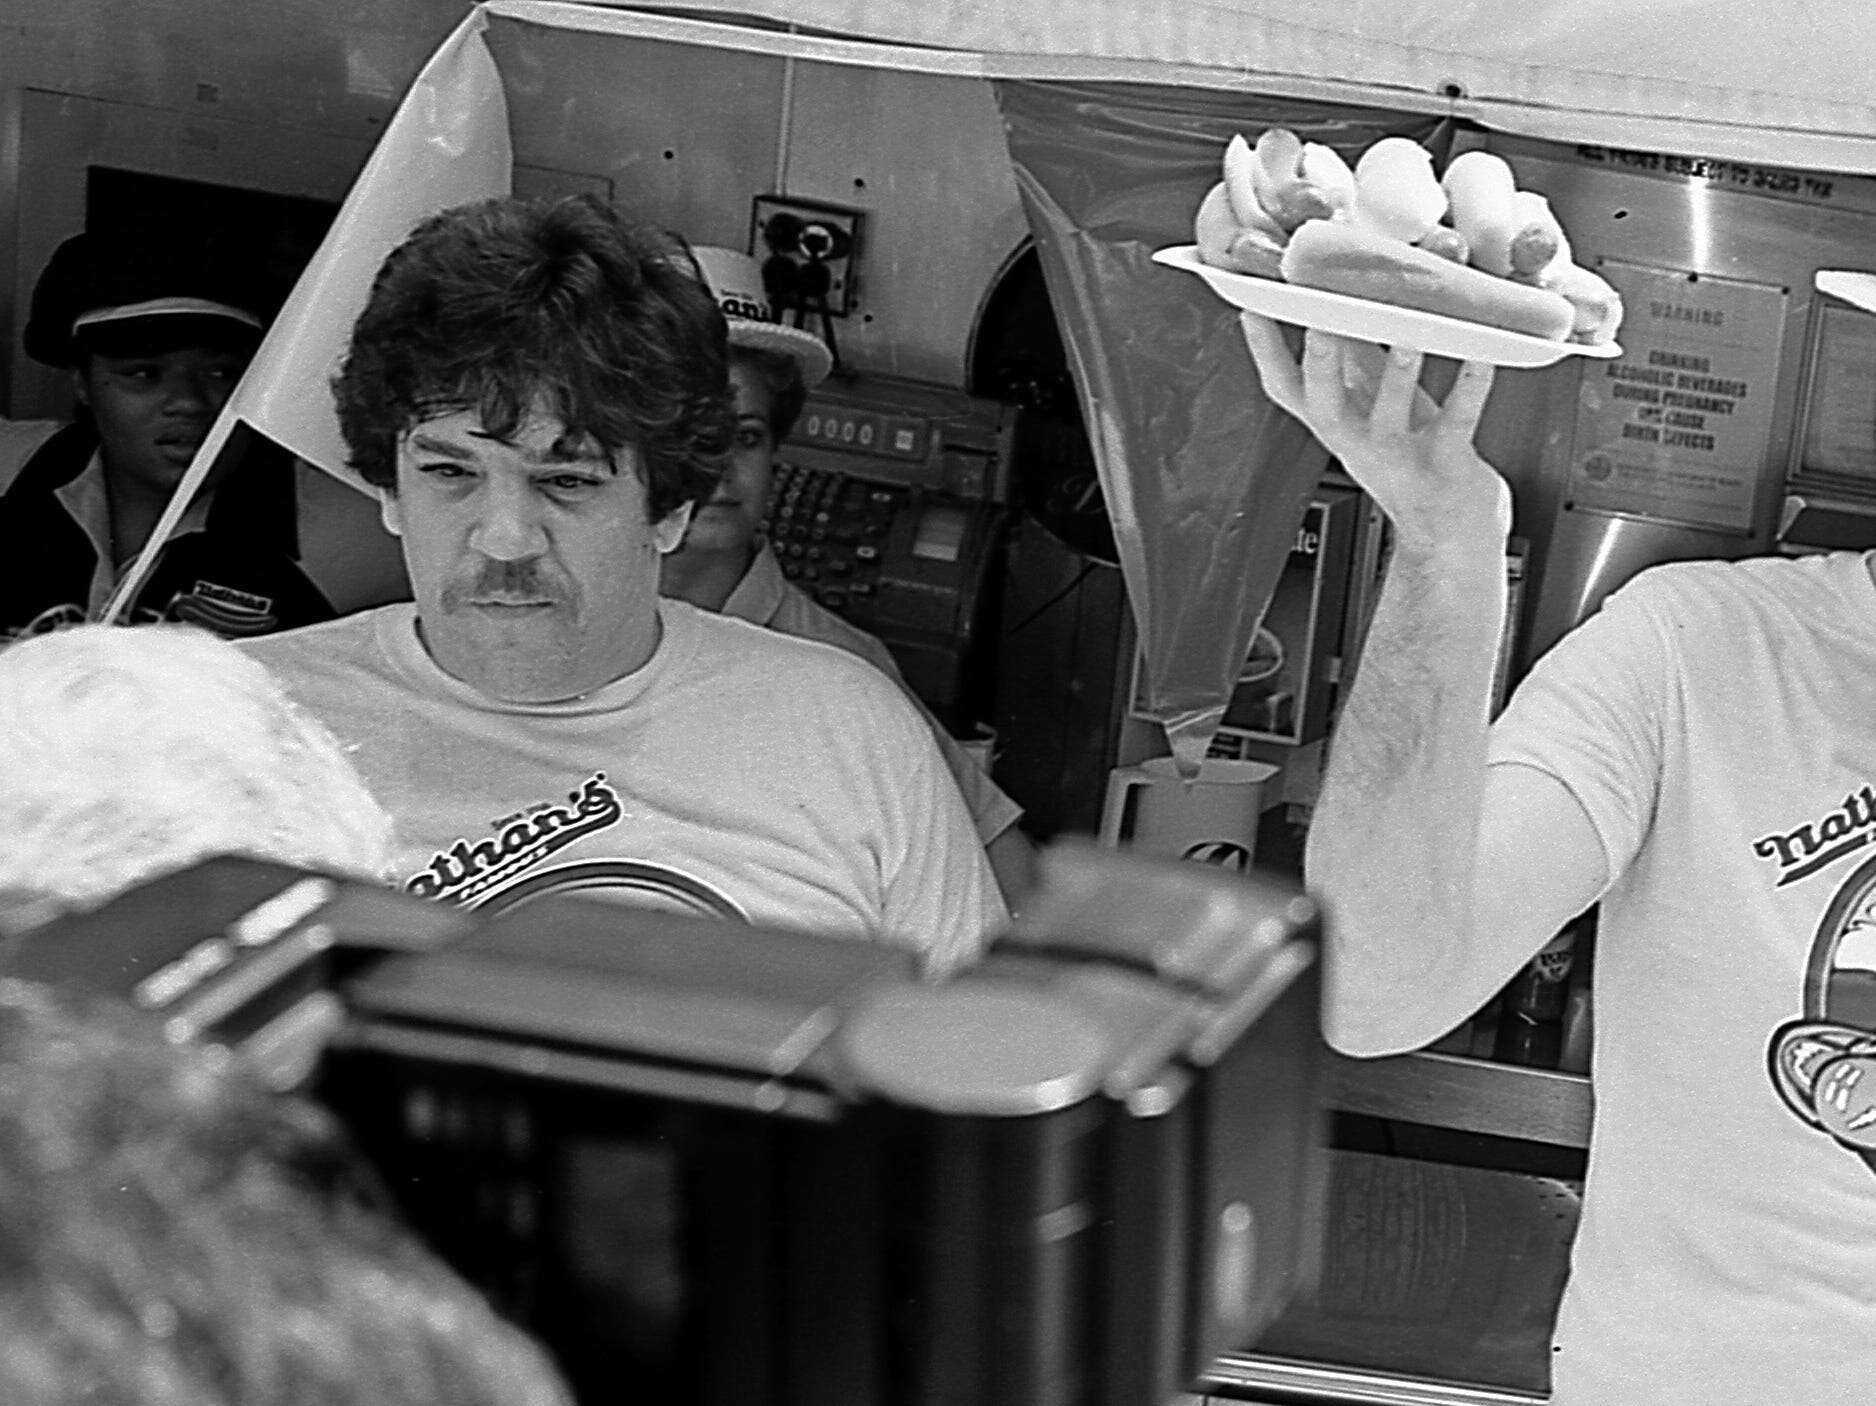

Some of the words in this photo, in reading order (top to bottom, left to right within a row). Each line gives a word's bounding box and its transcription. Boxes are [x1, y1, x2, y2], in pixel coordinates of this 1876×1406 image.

[1650, 301, 1726, 327] WARNING
[1649, 350, 1710, 373] DRINKING
[1606, 362, 1674, 387] ALCOHOLIC
[1677, 373, 1747, 399] BEVERAGES
[1613, 383, 1660, 403] DURING
[1662, 391, 1735, 415] PREGNANCY
[1621, 422, 1660, 442] BIRTH
[1664, 428, 1715, 451] DEFECTS
[405, 773, 616, 897] athan's
